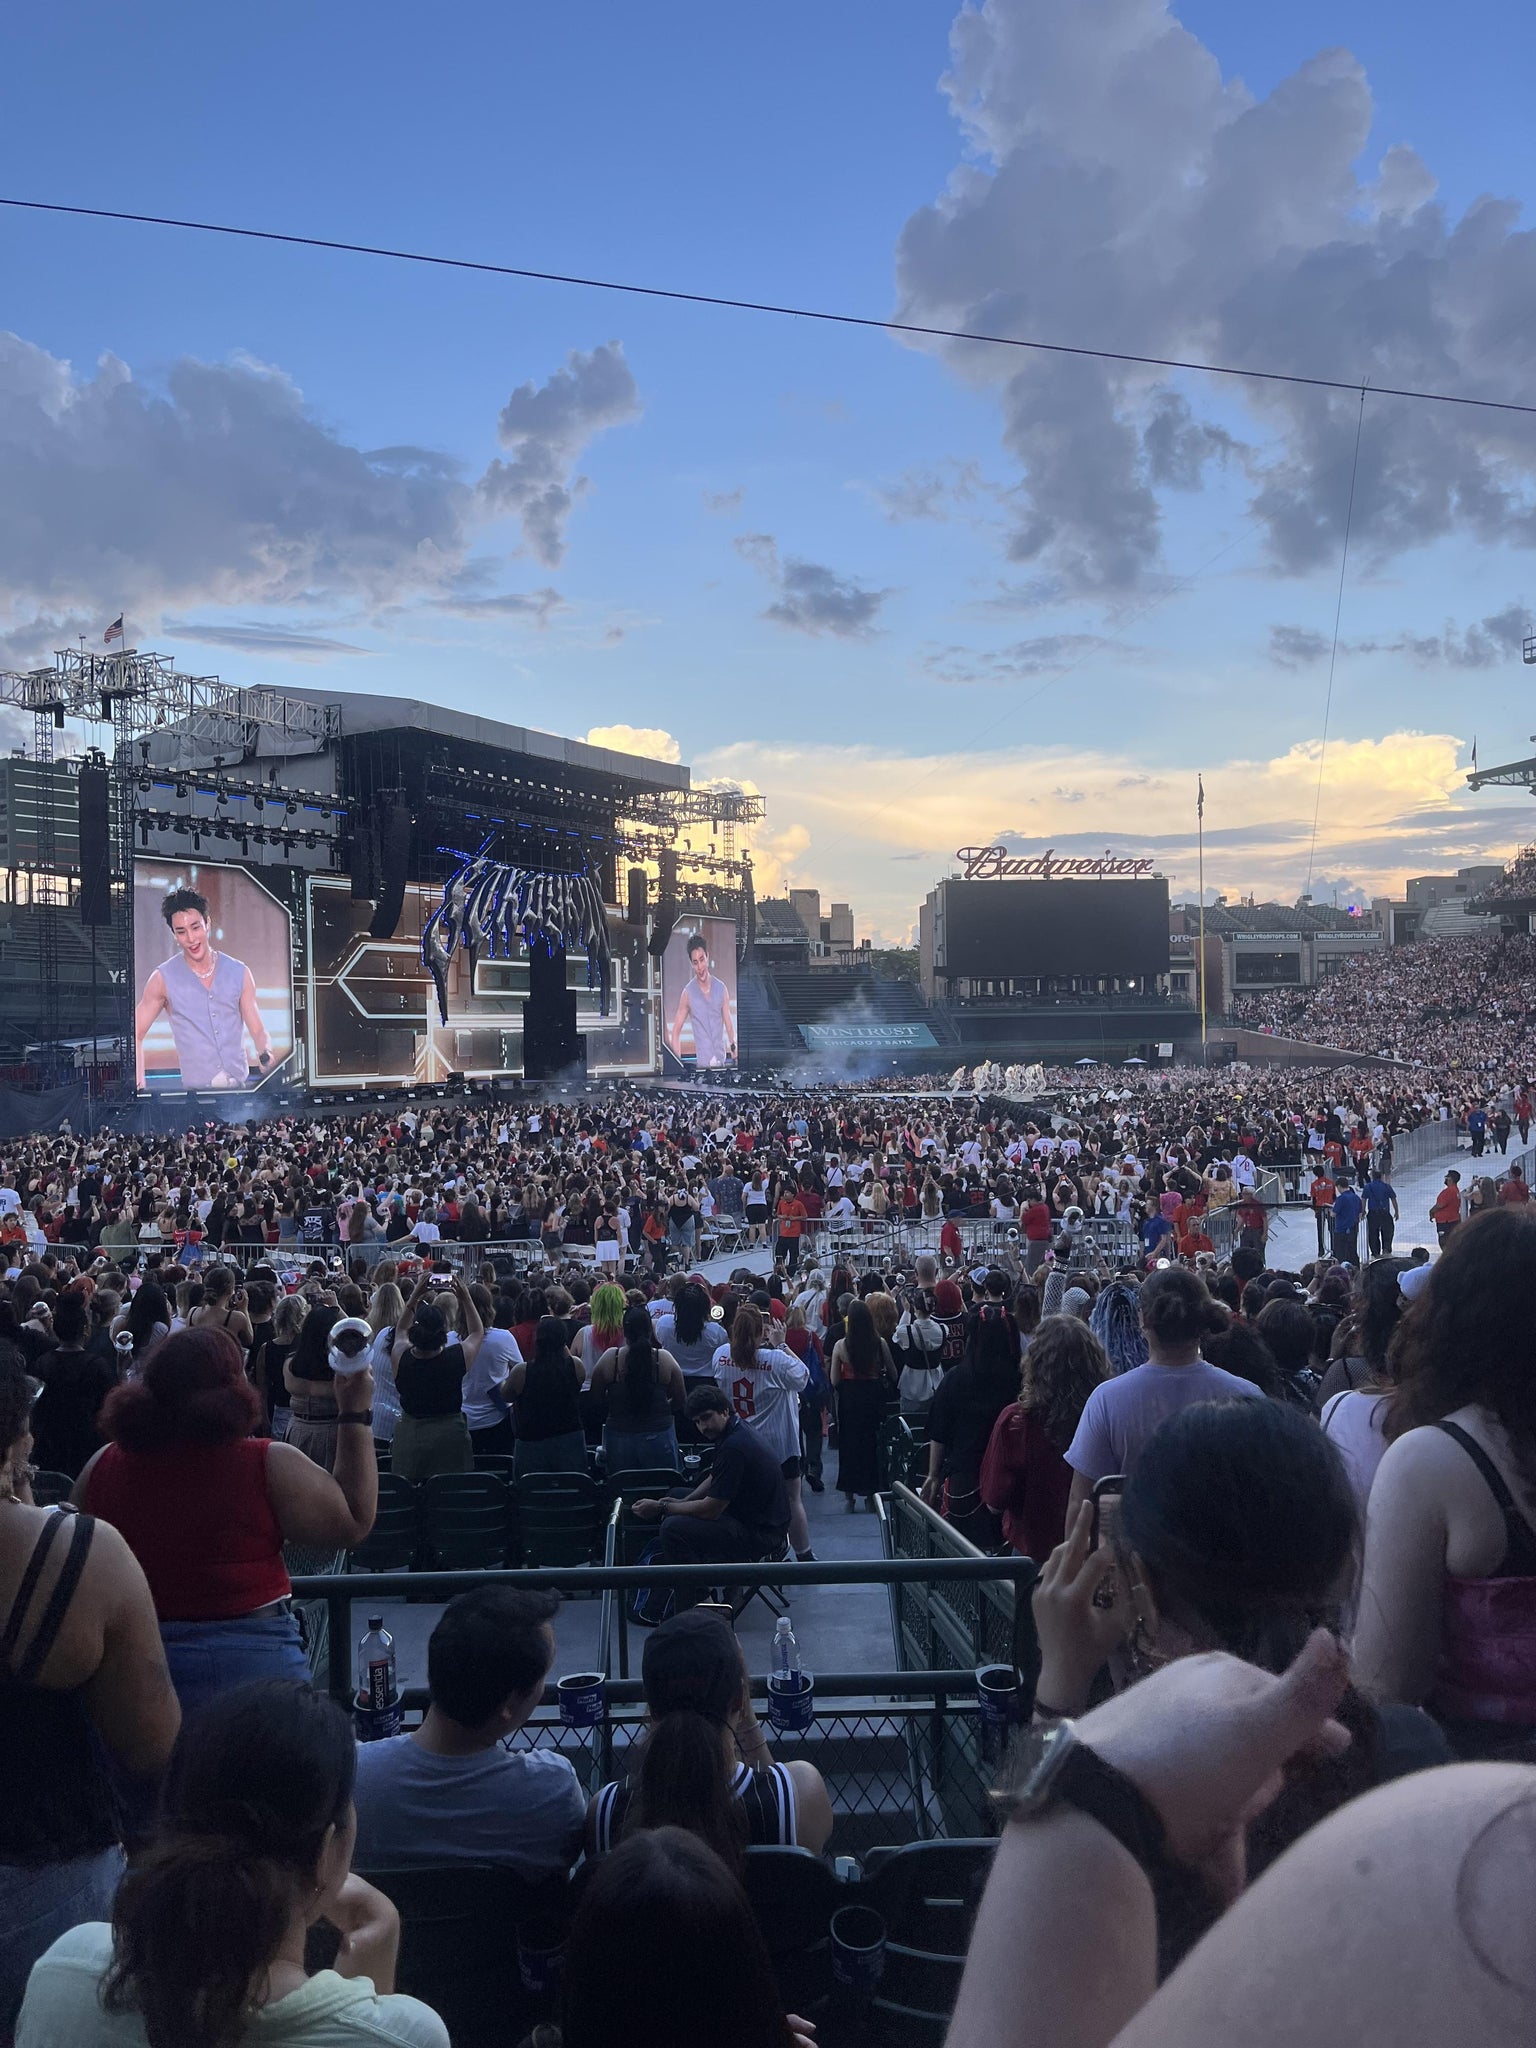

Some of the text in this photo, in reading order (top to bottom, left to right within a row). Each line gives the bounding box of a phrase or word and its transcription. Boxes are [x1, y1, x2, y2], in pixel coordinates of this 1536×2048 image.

[957, 846, 1154, 878] Budweiser
[808, 1026, 917, 1037] WINTRUST
[732, 1377, 756, 1419] 8
[373, 1667, 384, 1710] essentia
